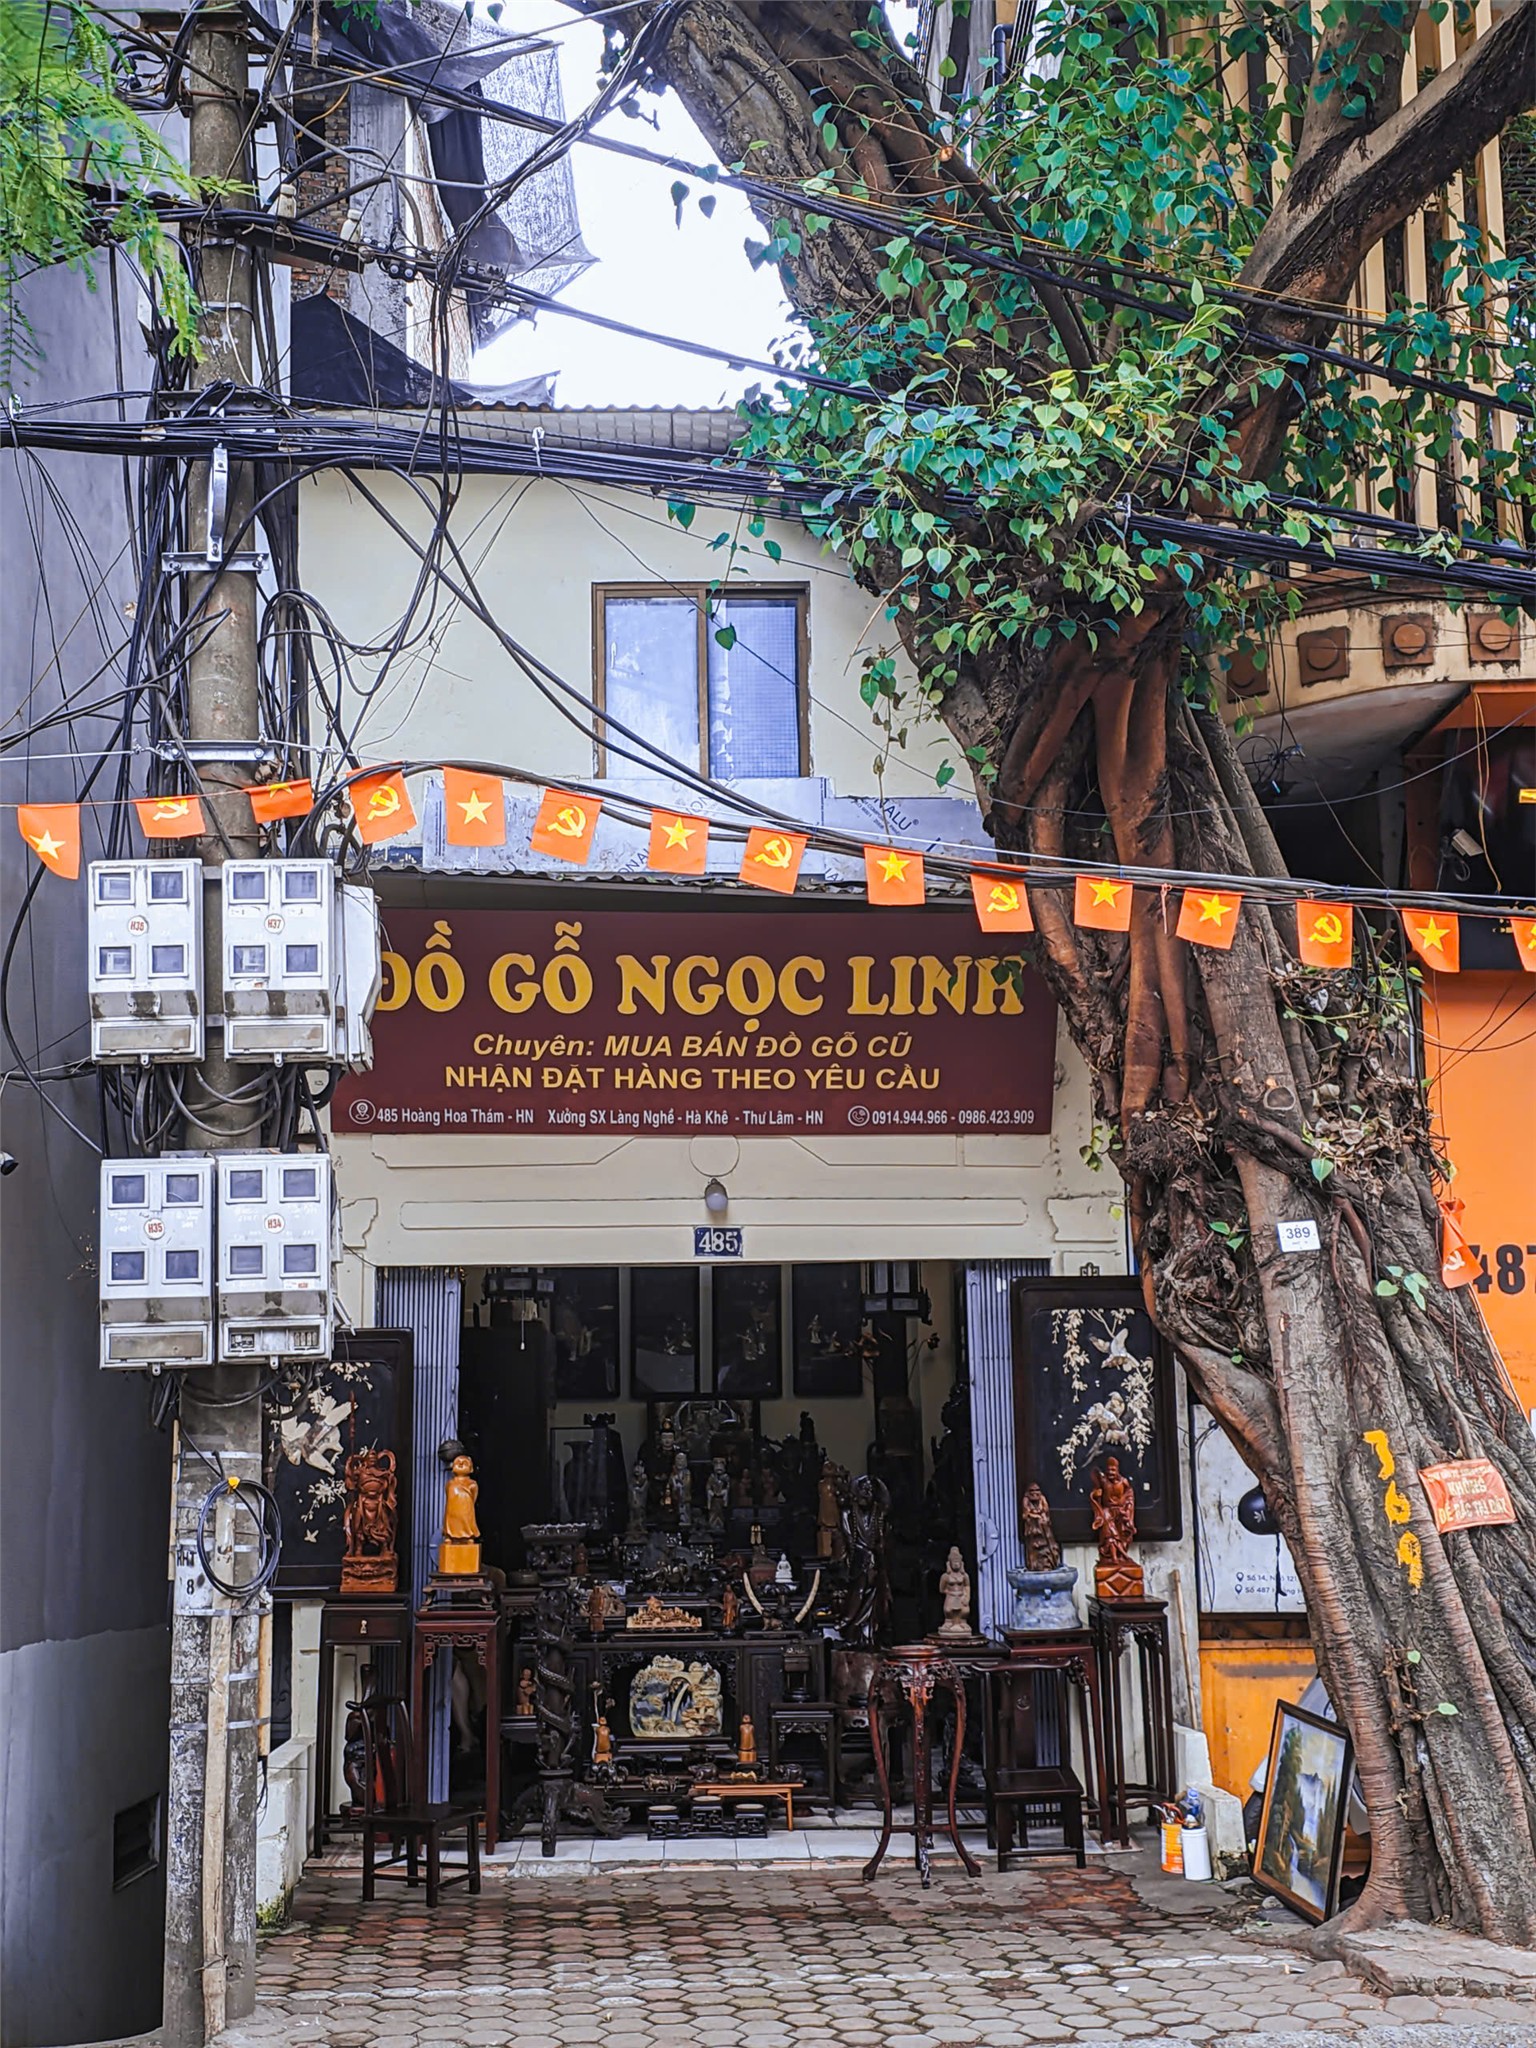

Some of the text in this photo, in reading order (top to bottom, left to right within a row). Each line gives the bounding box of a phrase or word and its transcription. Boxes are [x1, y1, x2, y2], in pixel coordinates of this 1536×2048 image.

[267, 919, 281, 930] H37
[375, 920, 1027, 1033] ĐỒ GỖ NGỌC LINH
[473, 1031, 913, 1061] Chuyên: MUA BÁN ĐỒ GỖ CŨ
[445, 1063, 940, 1094] NHẬN ĐẶT HÀNG THEO YÊU CẦU
[377, 1108, 398, 1123] 485
[402, 1107, 440, 1126] Hoàng
[444, 1108, 467, 1123] Hoa
[471, 1108, 504, 1123] Thám
[516, 1109, 534, 1124] HN
[547, 1108, 586, 1127] Xưởng
[590, 1109, 607, 1124] SX
[610, 1109, 639, 1128] Làng
[685, 1109, 702, 1125] Hà
[705, 1110, 729, 1125] Khê
[743, 1110, 767, 1125] Thư
[769, 1110, 794, 1125] Lâm
[806, 1110, 824, 1125] HN
[872, 1110, 948, 1125] 0914.944.966
[958, 1110, 1034, 1124] 0986.423.909
[148, 1223, 163, 1233] H35
[1286, 1226, 1311, 1239] 389
[698, 1231, 738, 1253] 485
